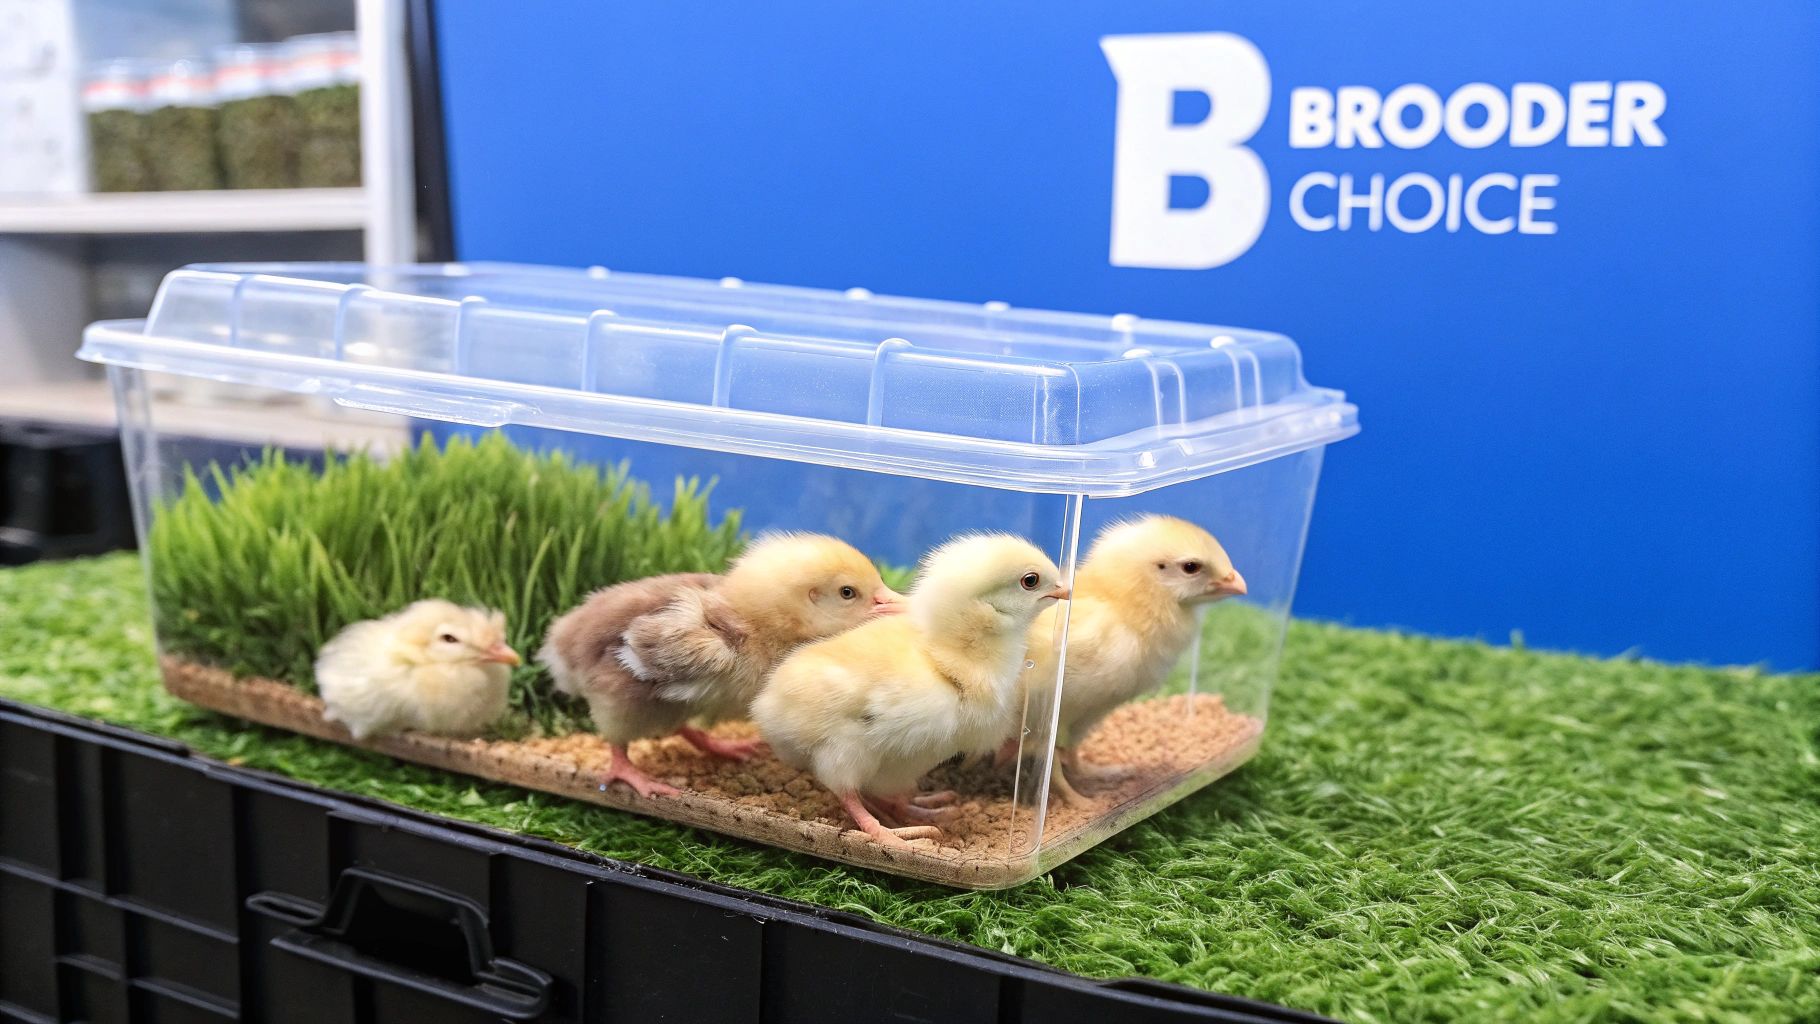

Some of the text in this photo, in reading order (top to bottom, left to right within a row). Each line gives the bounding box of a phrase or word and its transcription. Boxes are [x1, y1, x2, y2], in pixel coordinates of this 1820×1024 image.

[1289, 81, 1667, 149] BROODER
[1100, 32, 1271, 269] B
[1289, 172, 1558, 235] CHOICE
